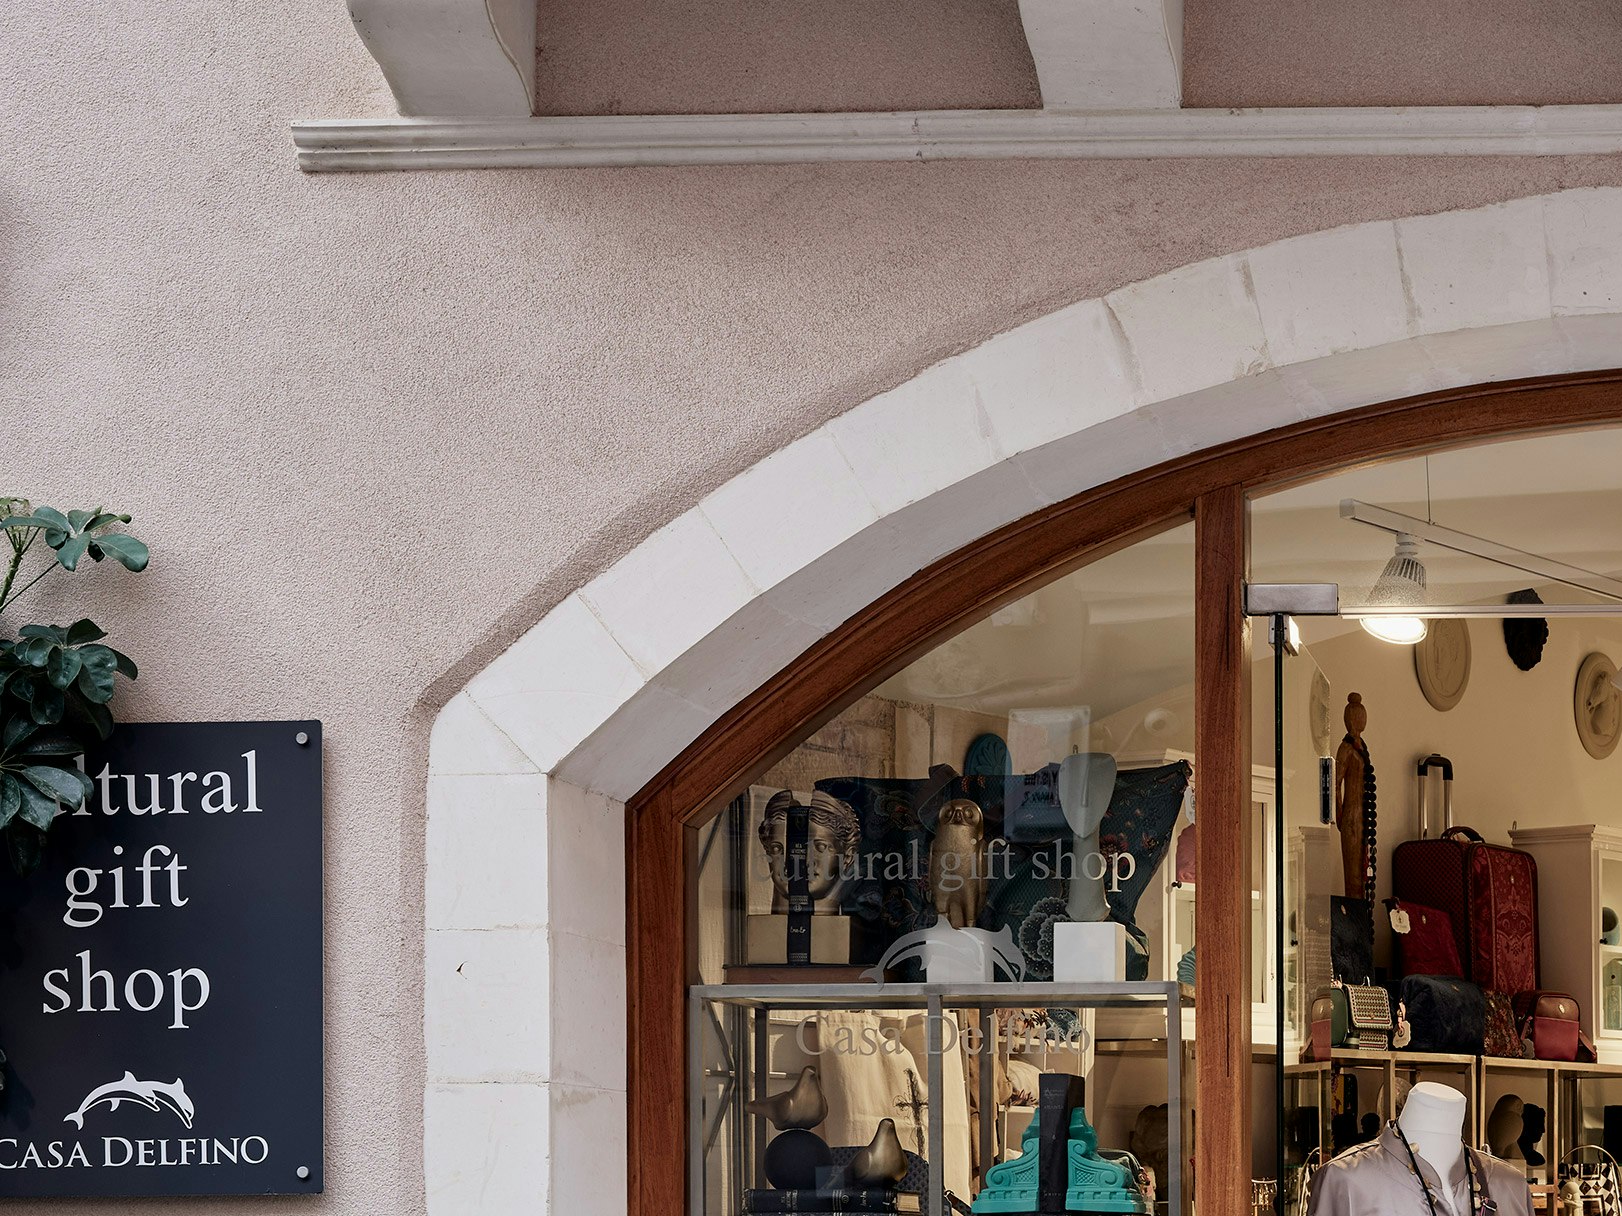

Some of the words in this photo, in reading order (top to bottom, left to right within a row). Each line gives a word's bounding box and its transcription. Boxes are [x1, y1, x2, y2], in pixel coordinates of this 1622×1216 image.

[54, 749, 264, 816] ltural
[62, 844, 190, 928] gift
[755, 837, 924, 882] cultural
[938, 838, 1016, 893] gift
[1031, 840, 1137, 893] shop
[42, 949, 210, 1030] shop
[795, 1014, 902, 1058] Casa
[920, 1012, 1092, 1057] Delfino
[0, 1139, 93, 1170] CASA
[102, 1135, 269, 1168] DELFINO
